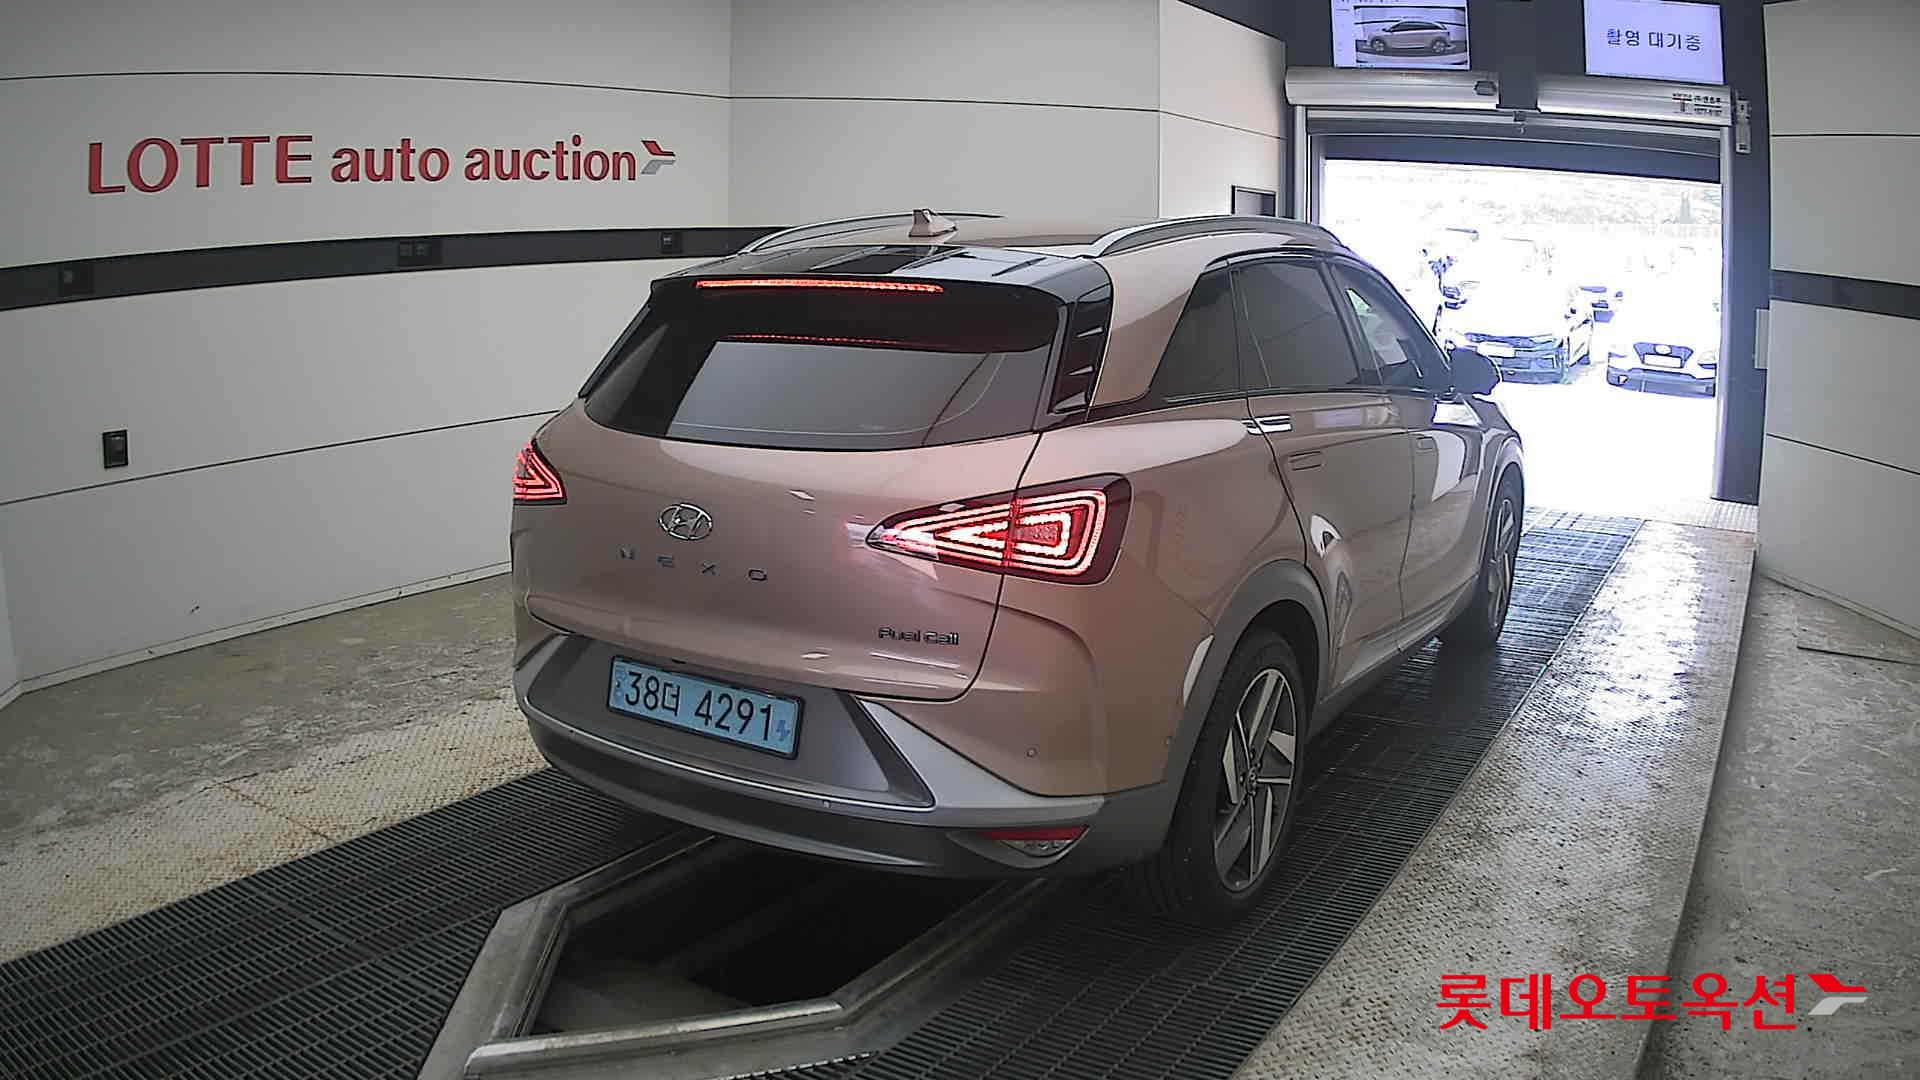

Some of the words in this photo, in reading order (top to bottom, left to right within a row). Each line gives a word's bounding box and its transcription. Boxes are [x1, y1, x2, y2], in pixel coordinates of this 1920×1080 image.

[1648, 31, 1701, 51] 대기중
[88, 135, 312, 194] LOTTE
[331, 138, 449, 182] auto
[464, 134, 637, 181] auction
[879, 627, 921, 642] Fuel
[924, 631, 960, 646] Cell
[624, 671, 680, 717] 38더
[695, 690, 772, 741] 4291
